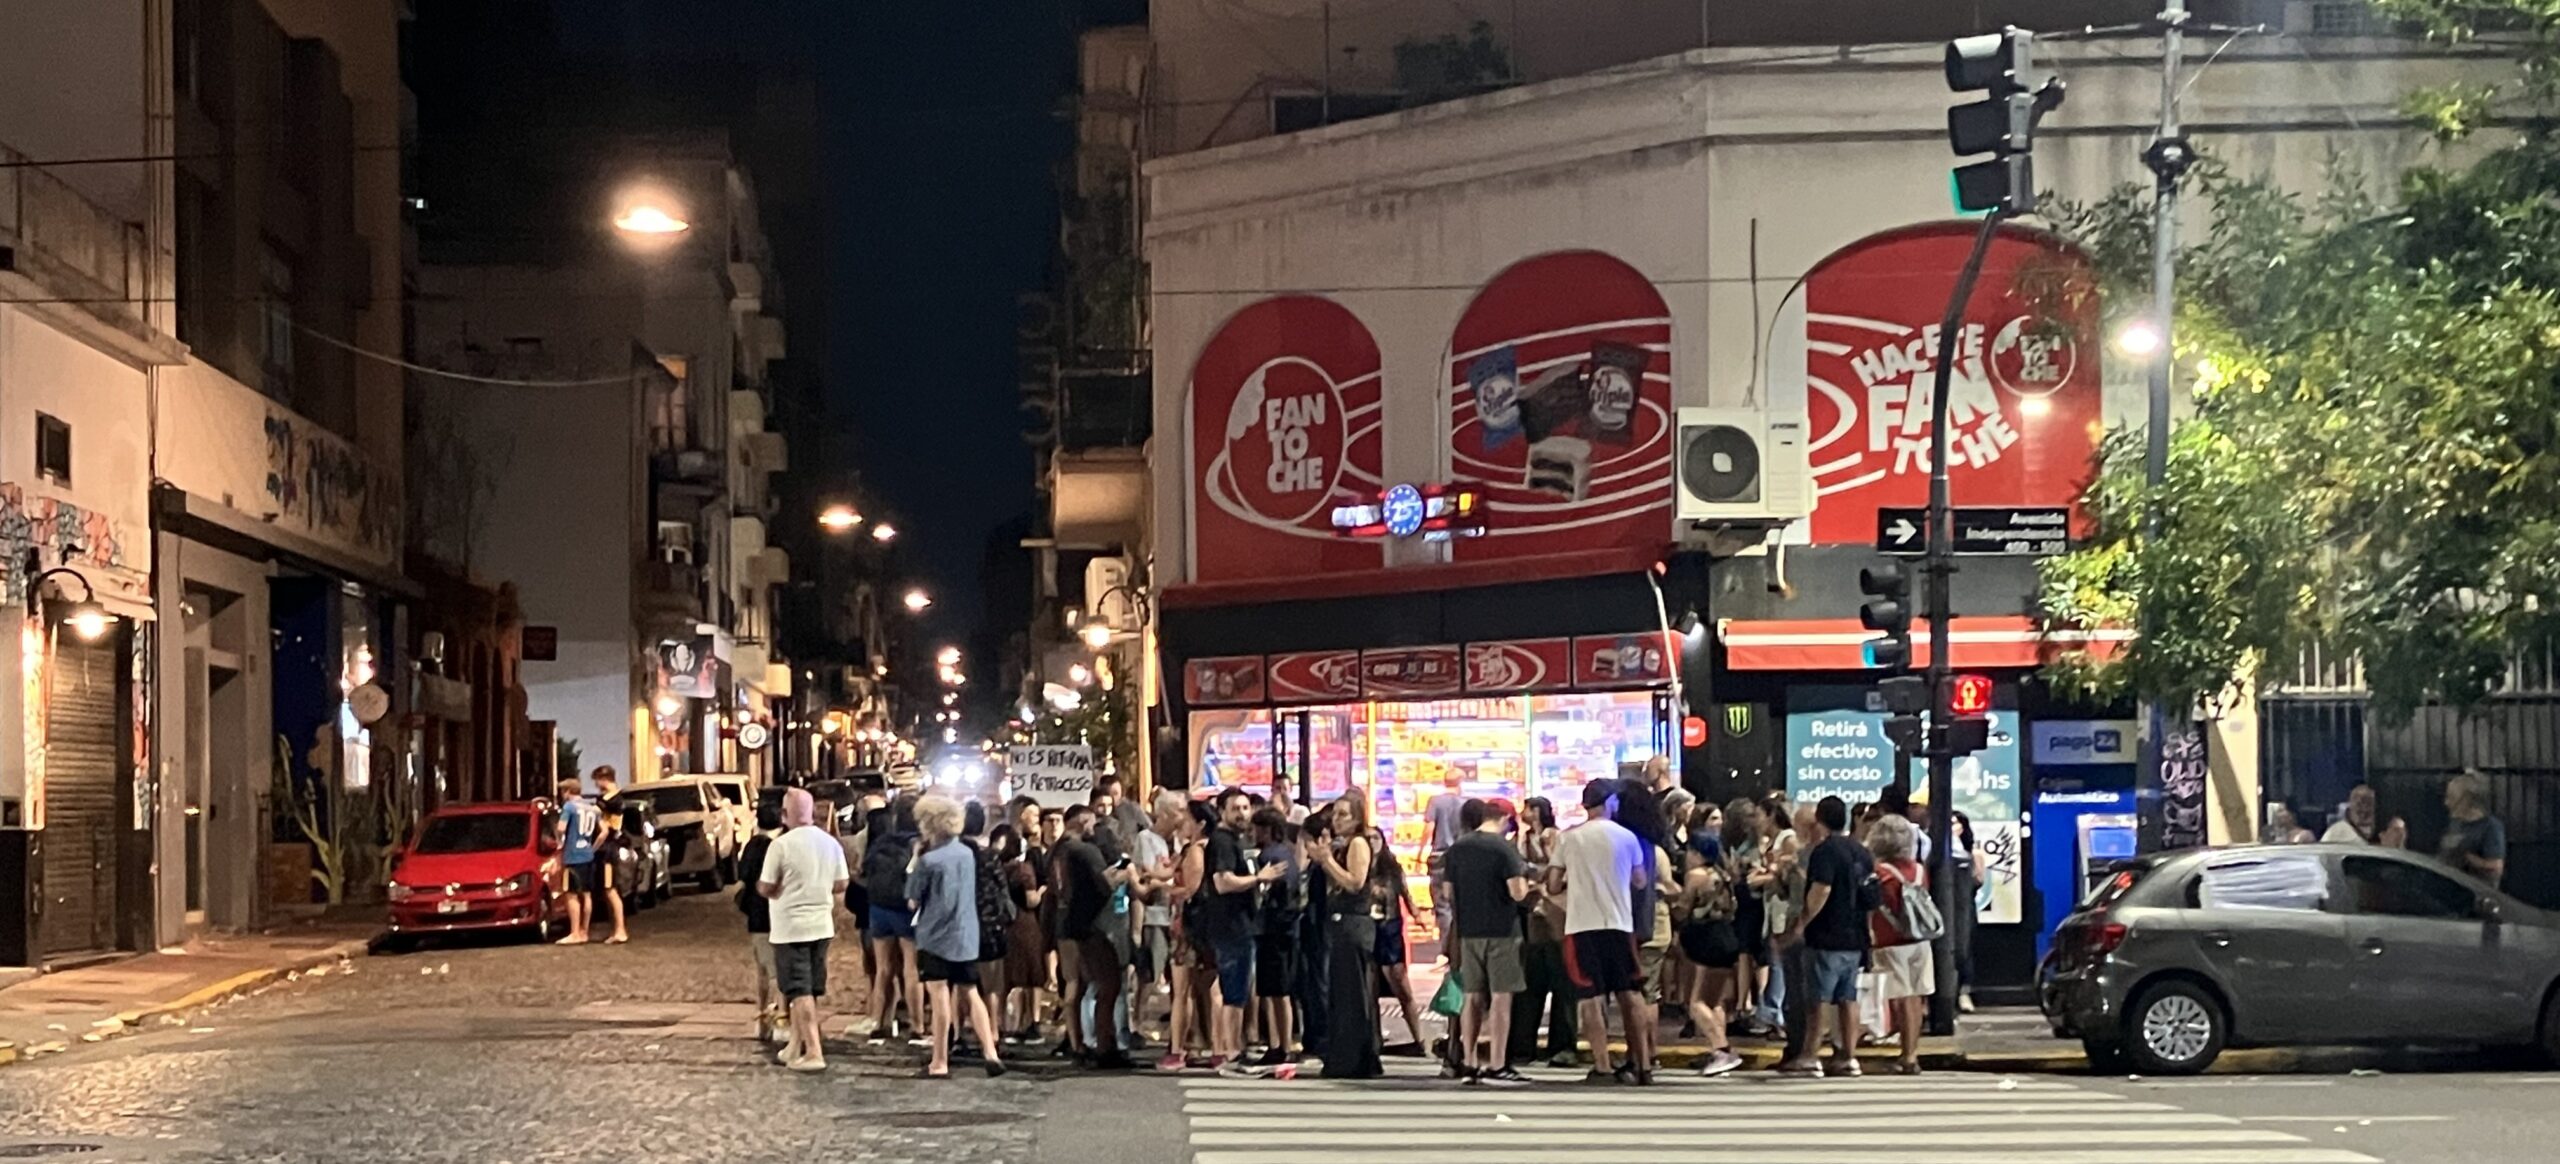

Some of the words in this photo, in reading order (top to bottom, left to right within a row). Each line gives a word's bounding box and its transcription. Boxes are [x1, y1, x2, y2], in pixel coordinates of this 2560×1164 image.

[1850, 323, 1984, 388] HACETE
[2020, 364, 2060, 380] CHE
[1266, 392, 1325, 432] FAN
[1868, 357, 2000, 452] FAN
[1268, 428, 1309, 462] TO
[1893, 413, 2020, 477] TOCHE
[1267, 456, 1323, 492] CHE
[2009, 512, 2065, 525] Avenida
[1966, 526, 2065, 541] Independencia
[1811, 720, 1867, 737] Retirá
[1028, 749, 1045, 766] ES
[1801, 743, 1879, 759] efectivo
[1798, 764, 1825, 780] sin
[1829, 765, 1882, 780] costo
[1950, 757, 2012, 796] 4hs
[2038, 790, 2120, 804] Automático
[577, 809, 595, 837] 10
